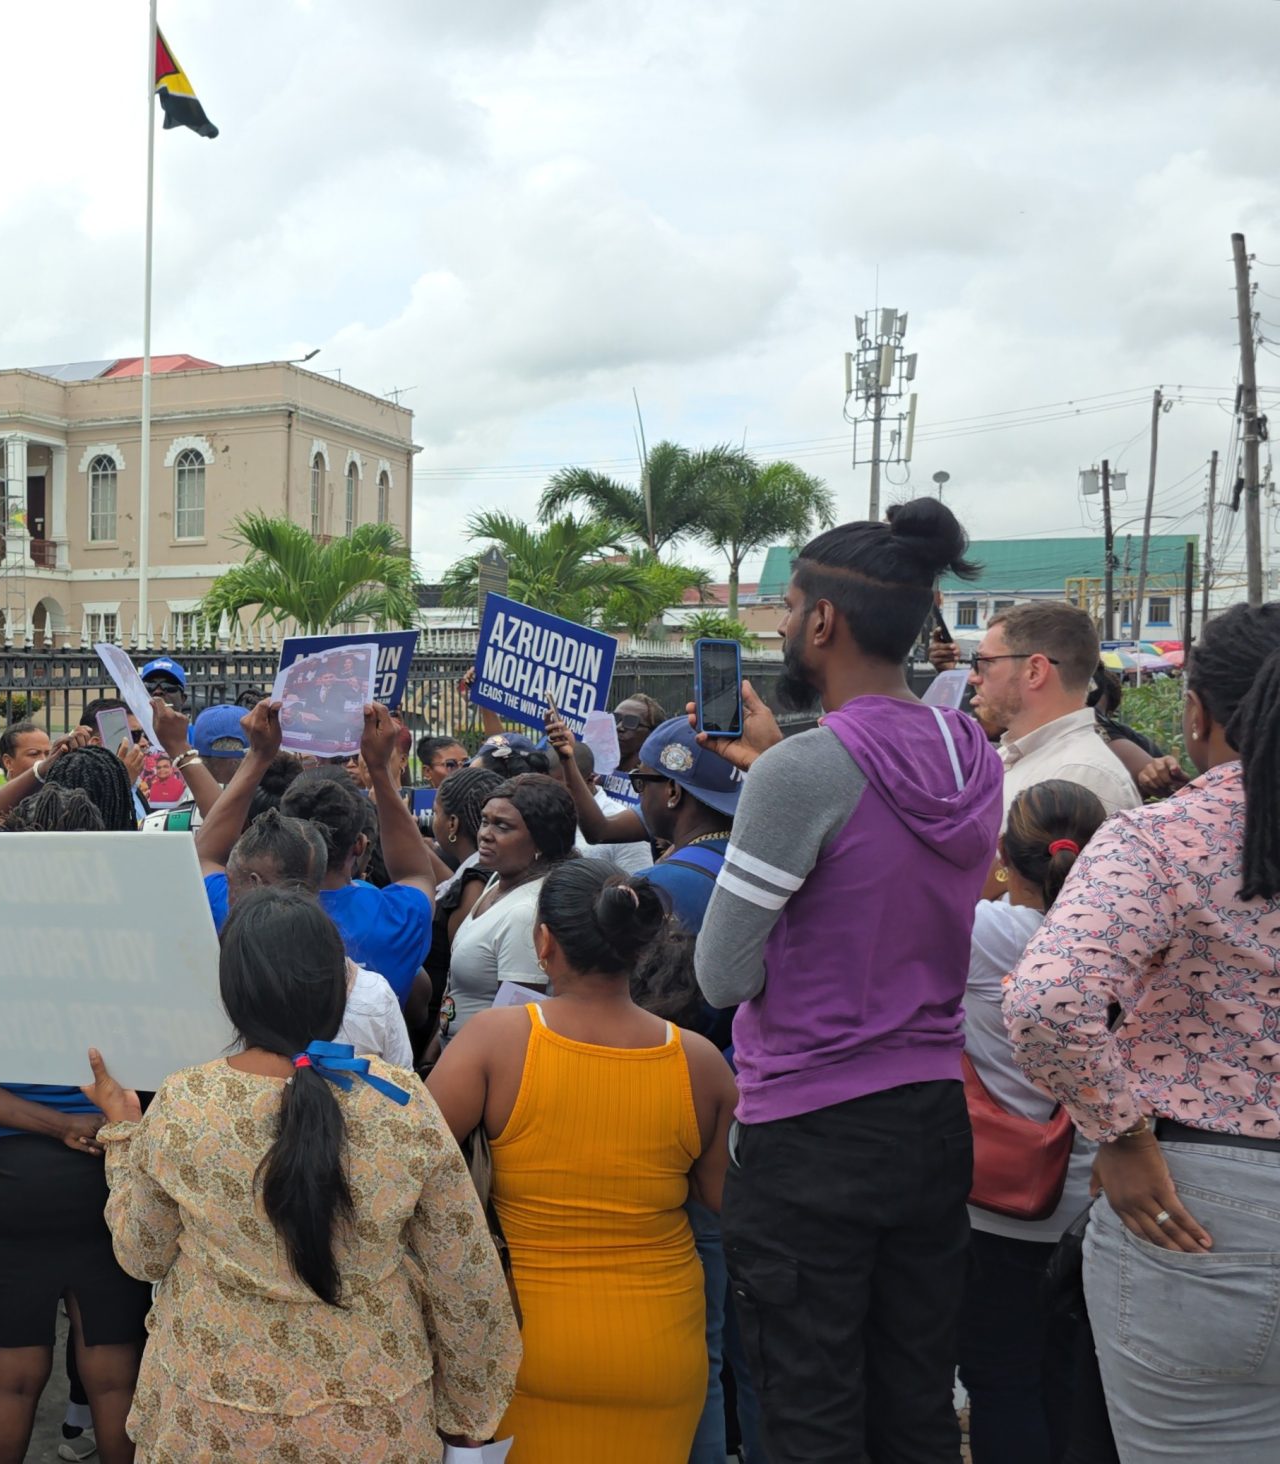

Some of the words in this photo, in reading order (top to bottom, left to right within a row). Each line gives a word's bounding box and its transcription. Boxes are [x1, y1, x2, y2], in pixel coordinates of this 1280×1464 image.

[481, 646, 597, 719] MOHAMED
[488, 611, 603, 684] AZRUDDIN
[478, 681, 503, 703] LEADS
[503, 692, 520, 710] THE
[520, 698, 537, 717] WIN
